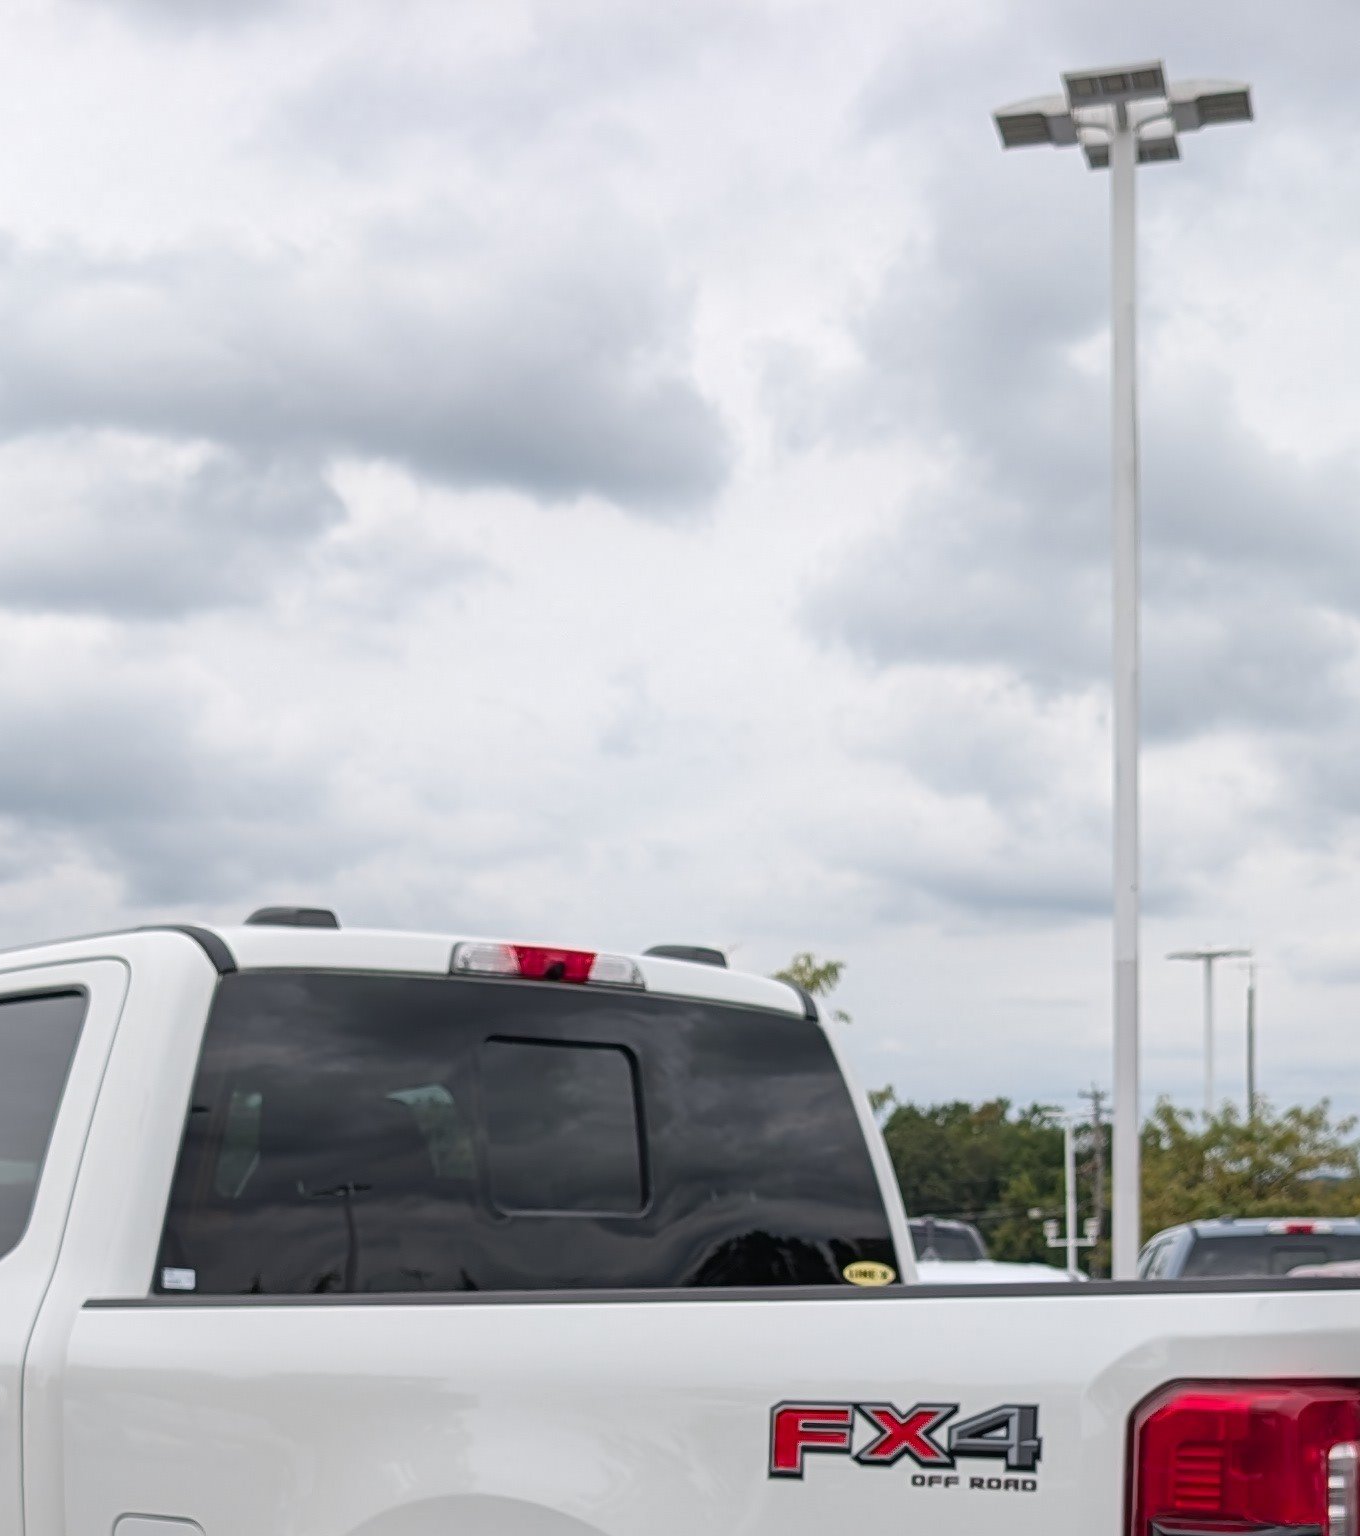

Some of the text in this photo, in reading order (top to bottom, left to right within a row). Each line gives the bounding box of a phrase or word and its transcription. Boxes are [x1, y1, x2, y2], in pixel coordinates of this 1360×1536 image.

[768, 1400, 1041, 1480] FX4
[911, 1474, 1037, 1492] OFF ROAD
